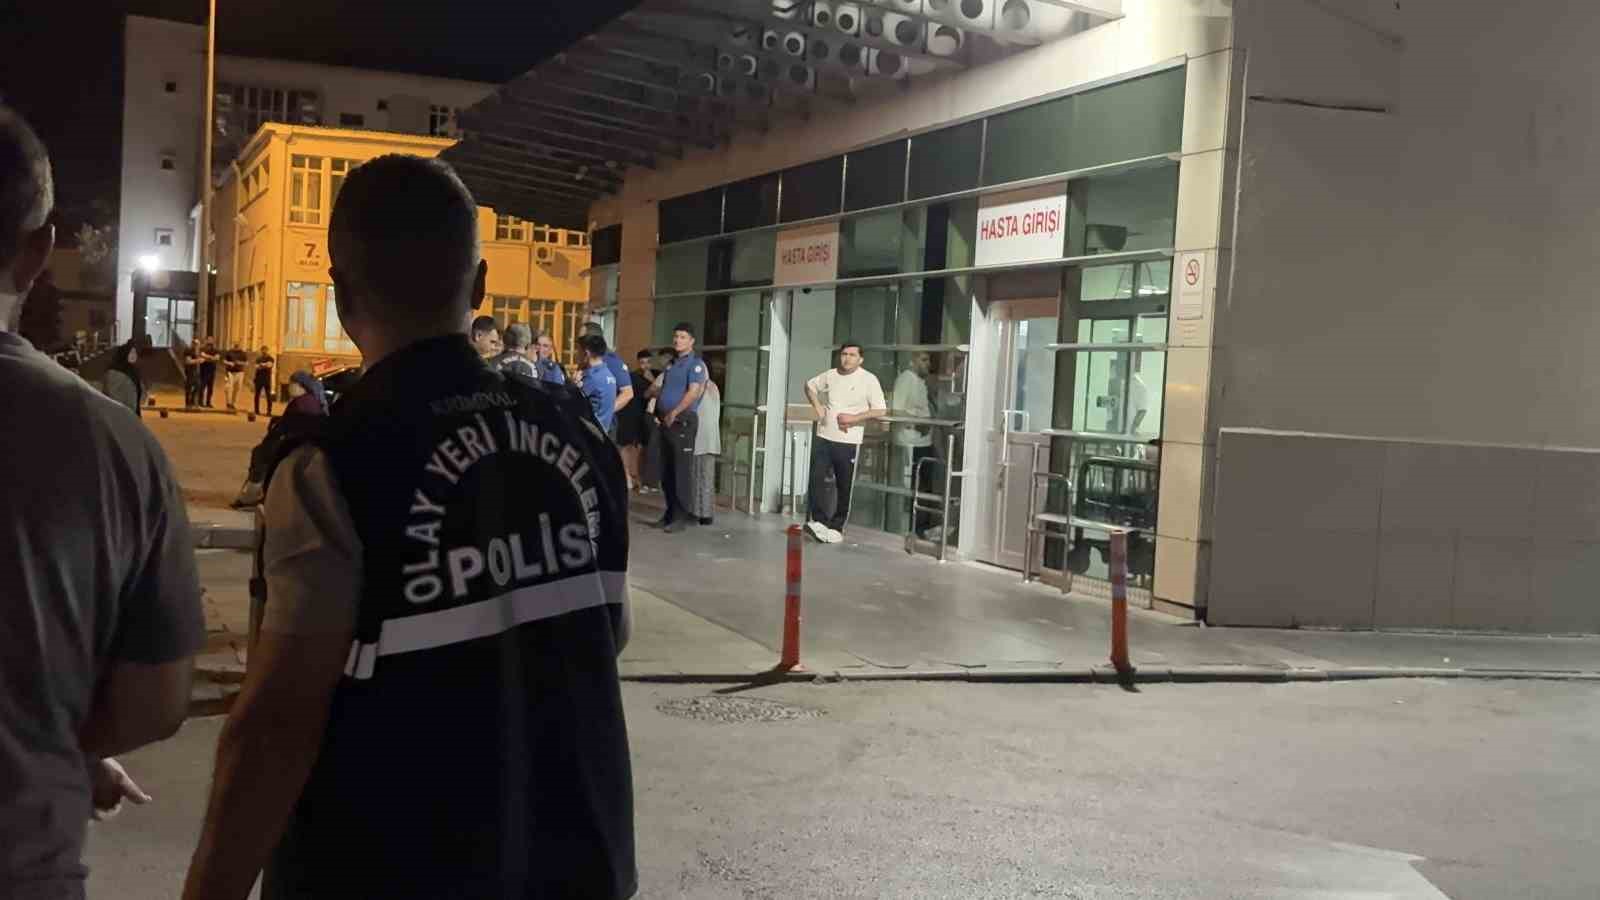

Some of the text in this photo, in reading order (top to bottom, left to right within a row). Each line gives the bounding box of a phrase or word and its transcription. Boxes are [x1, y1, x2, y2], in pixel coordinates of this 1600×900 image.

[782, 247, 806, 265] HASTA
[980, 203, 1062, 241] HASTA GİRİŞİ
[424, 412, 498, 486] YERİ
[403, 488, 447, 604] OLAY
[448, 511, 592, 598] POLİS
